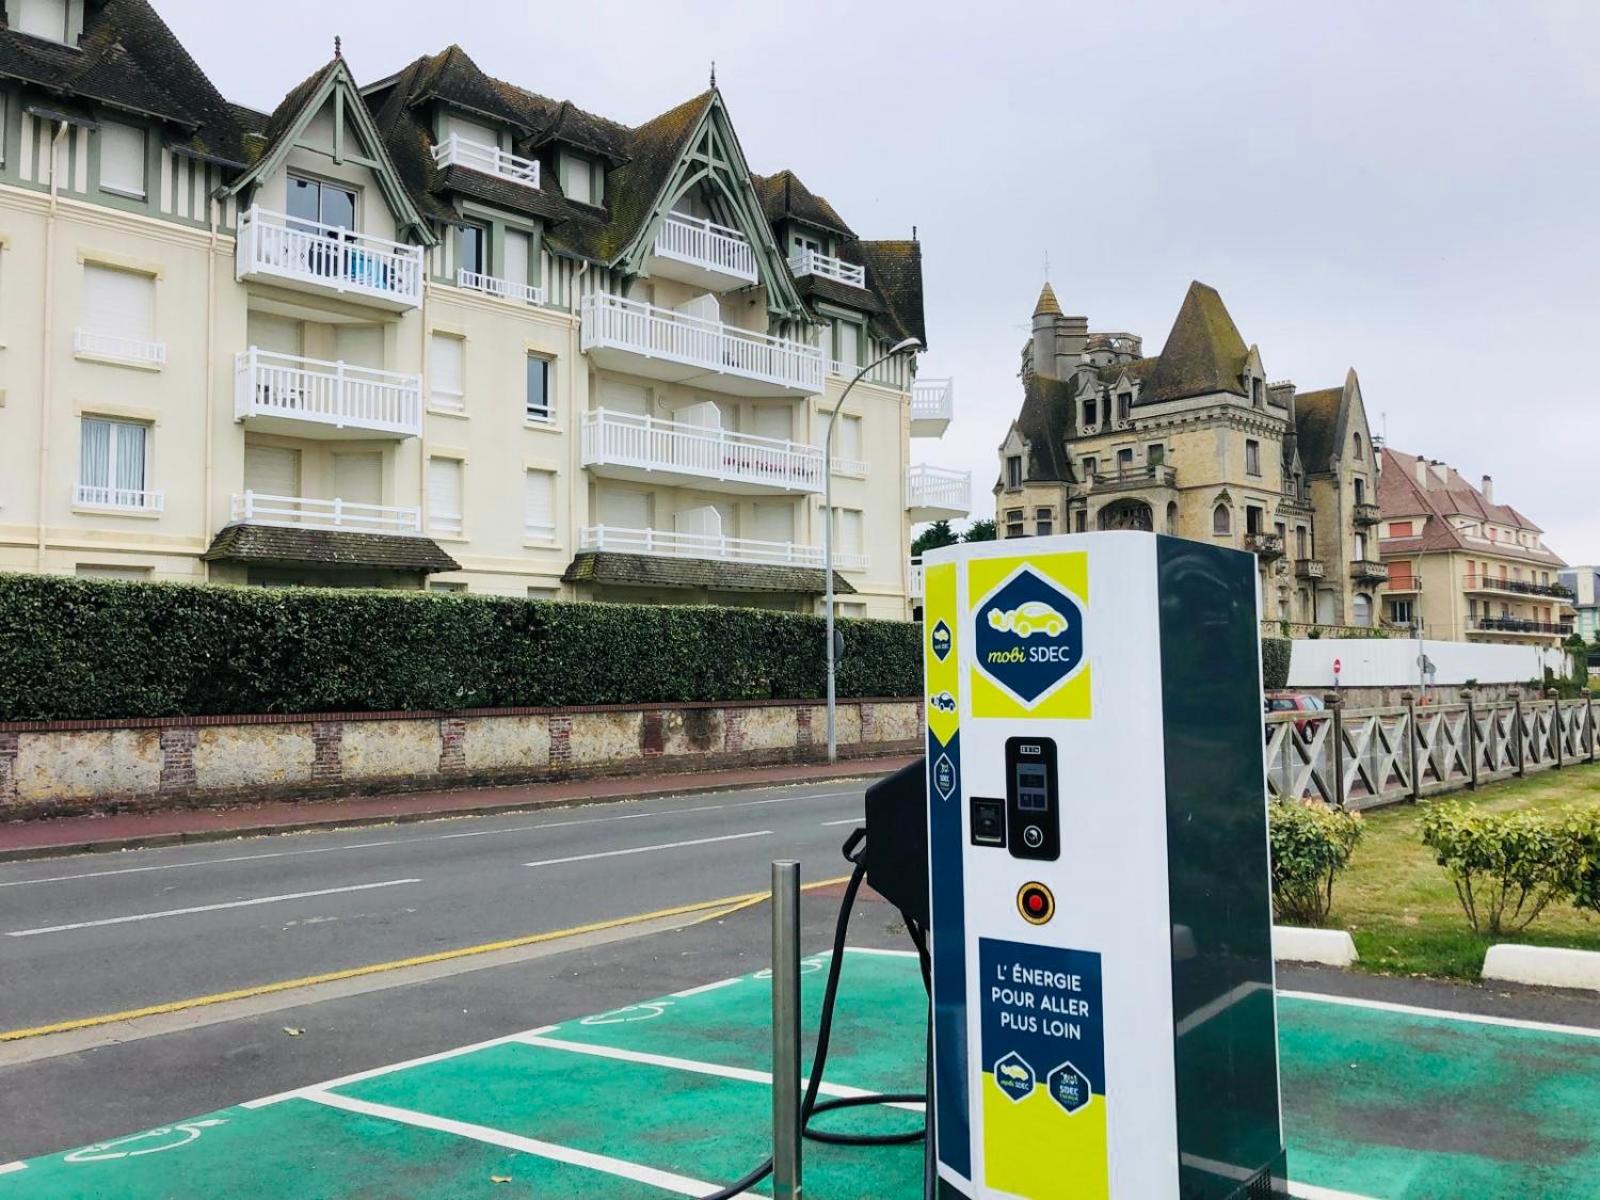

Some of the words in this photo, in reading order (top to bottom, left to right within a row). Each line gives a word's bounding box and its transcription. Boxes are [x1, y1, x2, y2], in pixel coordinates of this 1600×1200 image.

[988, 646, 1026, 663] mobi
[1029, 646, 1070, 662] SDEC
[1012, 962, 1082, 992] ÉNERGIE
[991, 986, 1035, 1009] POUR
[1040, 994, 1089, 1018] ALLER
[1001, 1011, 1038, 1033] PLUS
[1042, 1018, 1081, 1041] LOIN
[1059, 1085, 1079, 1096] SDEC
